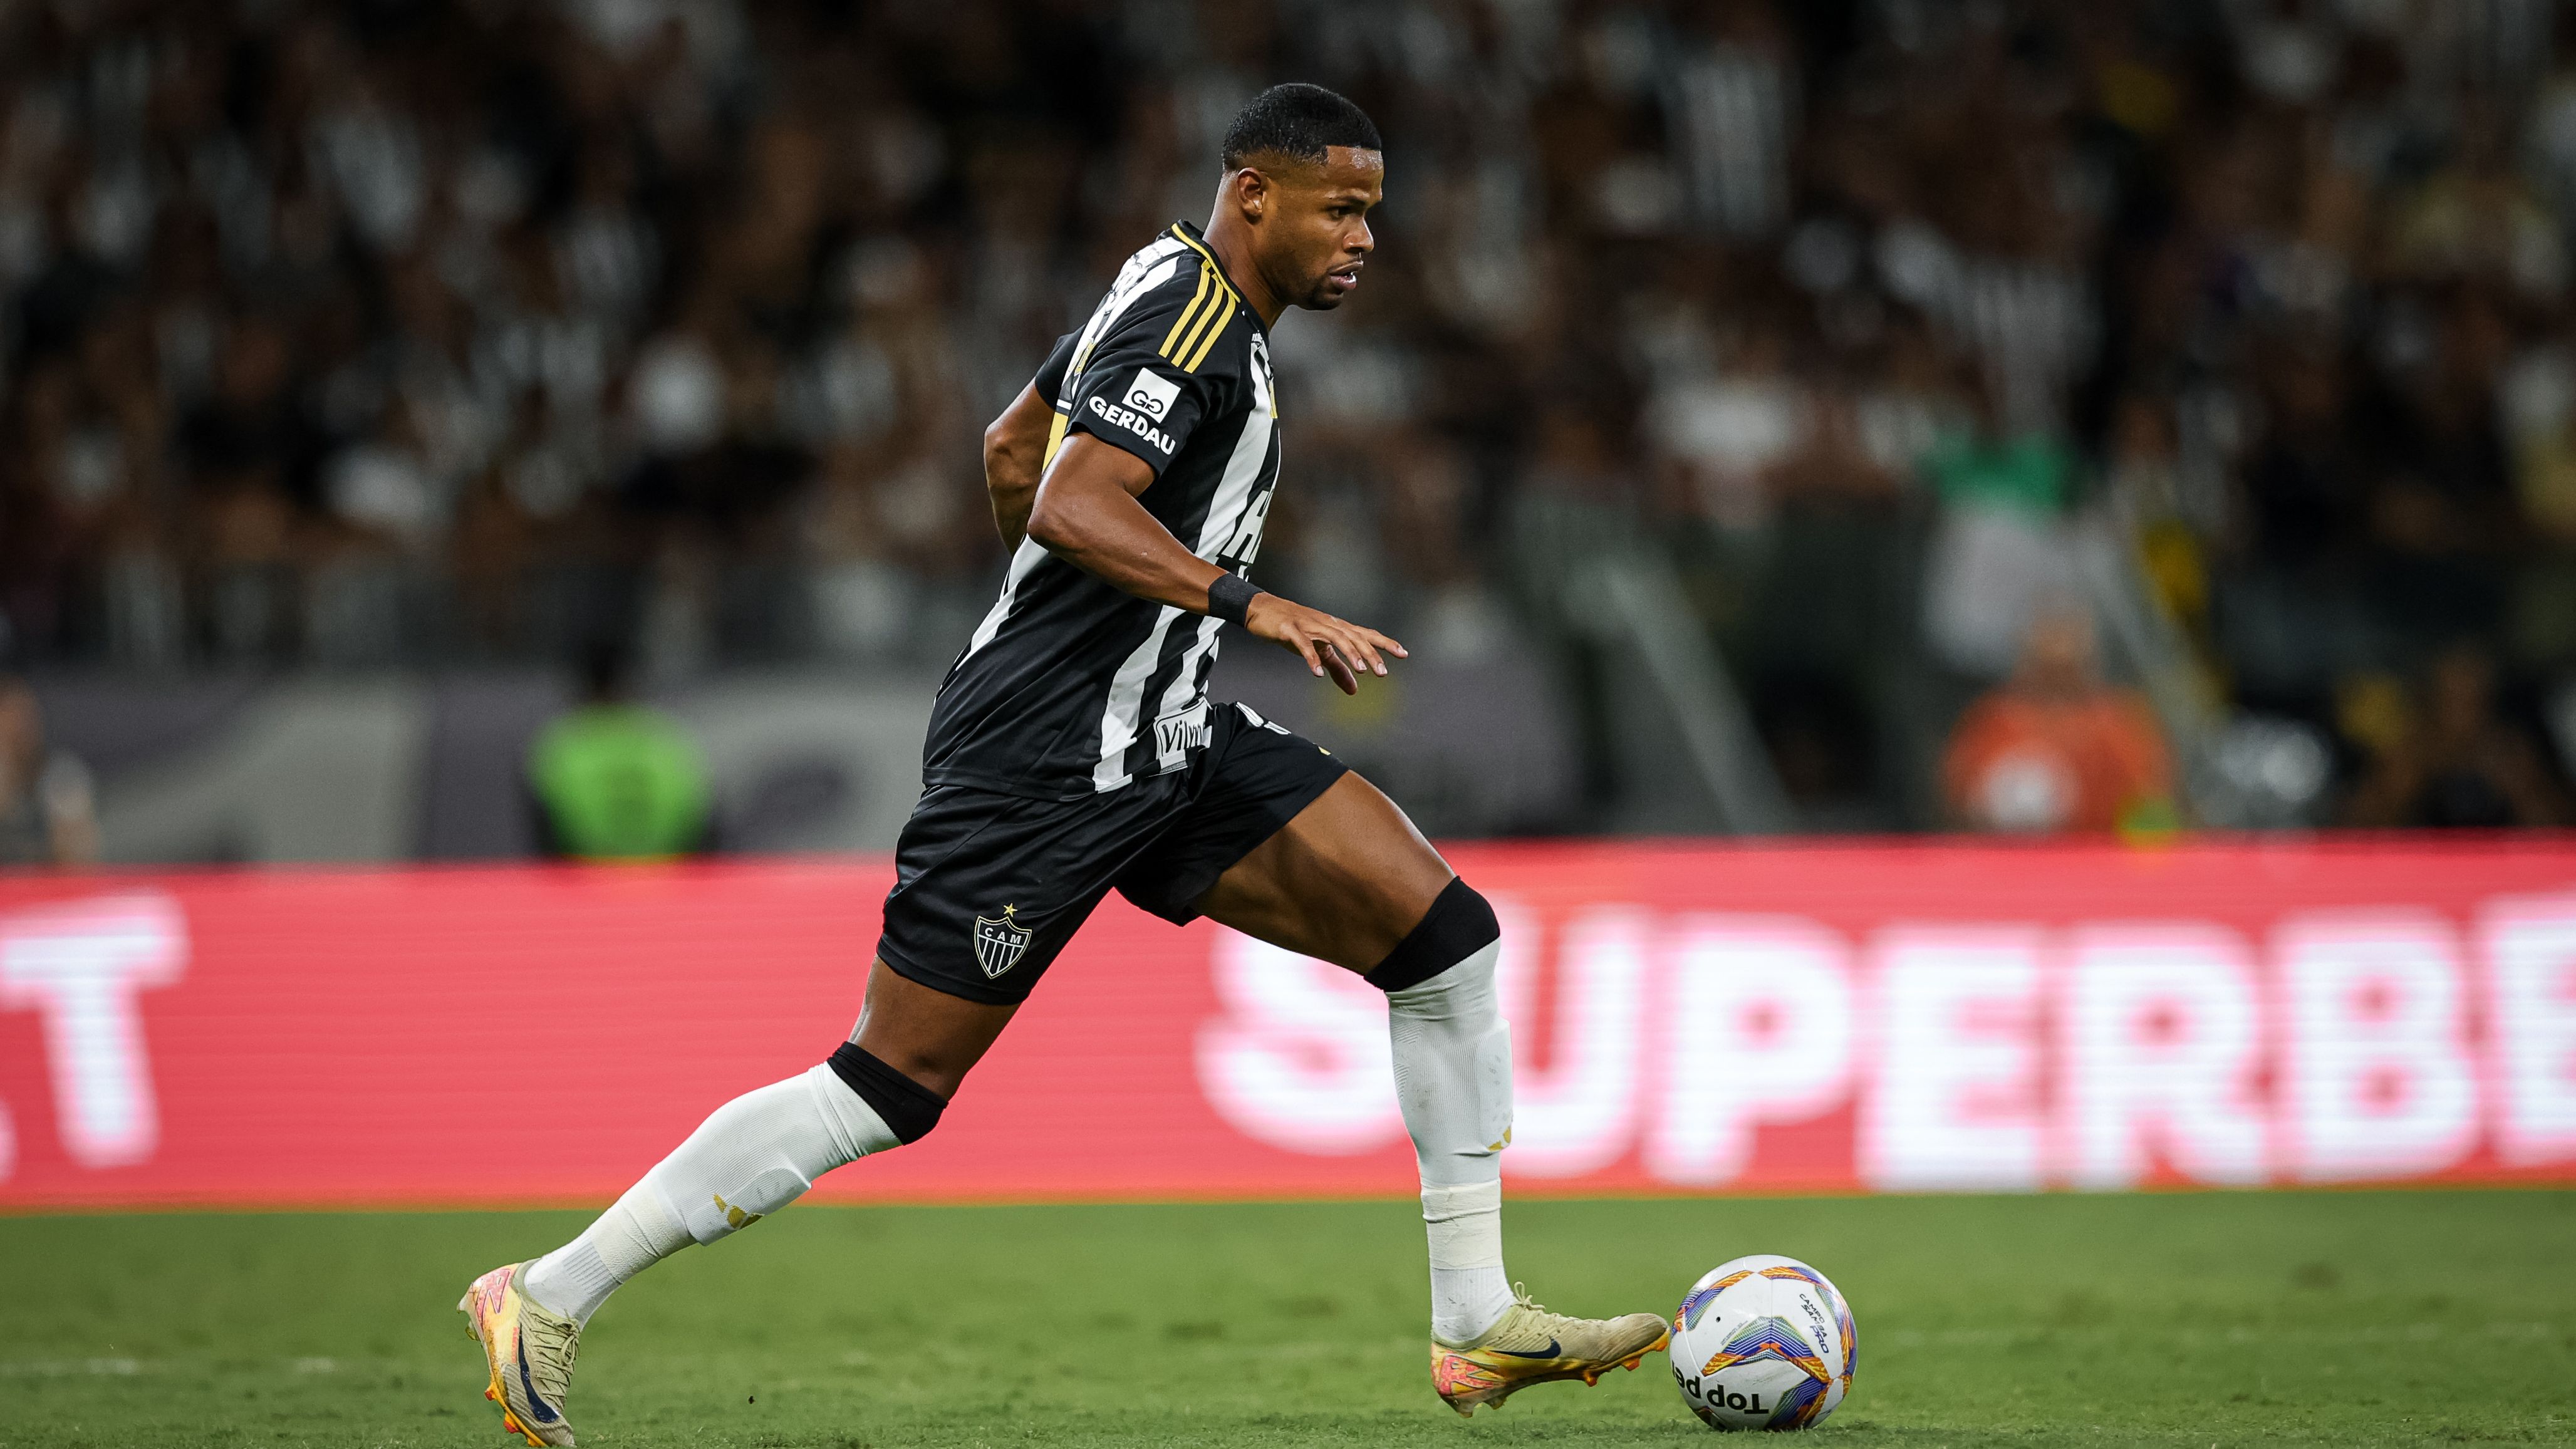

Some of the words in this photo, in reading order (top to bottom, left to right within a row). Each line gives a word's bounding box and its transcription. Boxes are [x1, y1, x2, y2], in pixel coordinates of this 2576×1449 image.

[1089, 396, 1176, 455] GERDAU
[1161, 719, 1203, 754] Vilm
[1799, 1293, 1826, 1324] CAMPO
[1800, 1304, 1828, 1338] SAMBA
[1809, 1324, 1829, 1354] PRO
